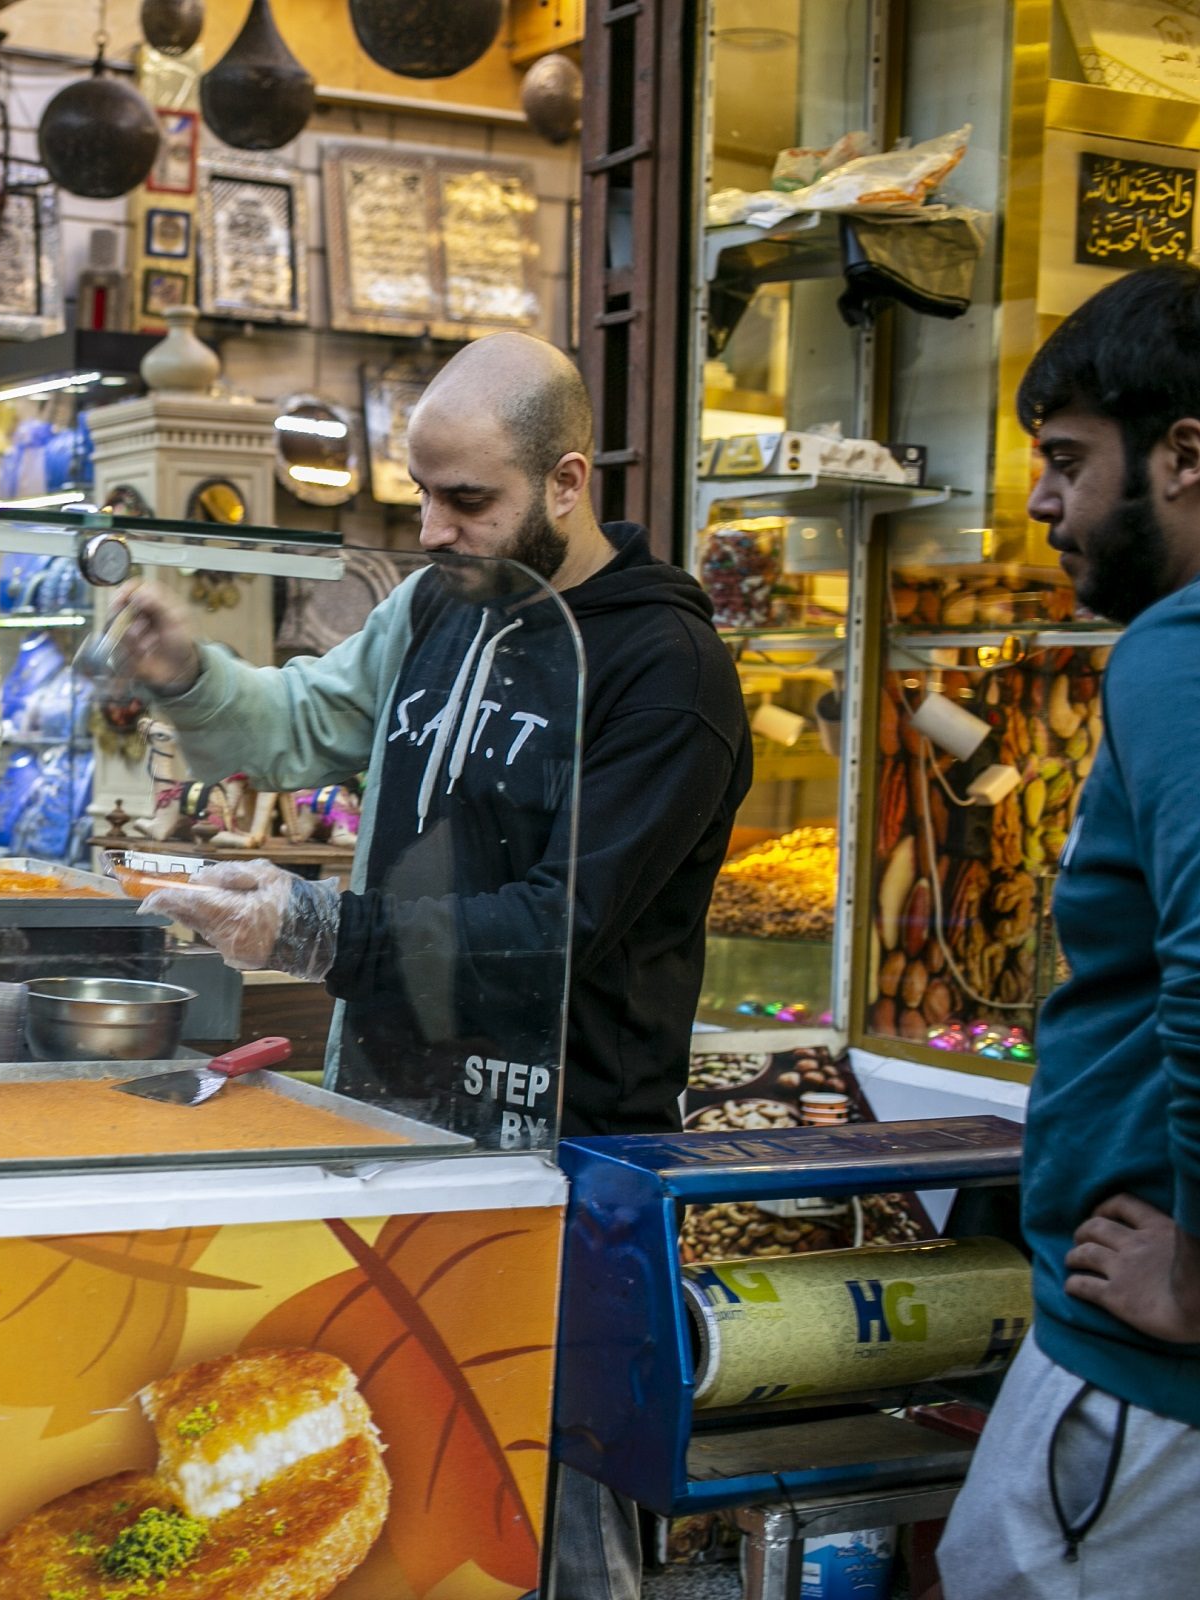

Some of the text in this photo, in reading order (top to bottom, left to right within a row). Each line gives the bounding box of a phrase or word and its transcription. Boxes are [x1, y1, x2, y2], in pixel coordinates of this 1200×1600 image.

[464, 1055, 550, 1108] STEP
[500, 1111, 548, 1150] BY
[844, 1279, 928, 1343] HG
